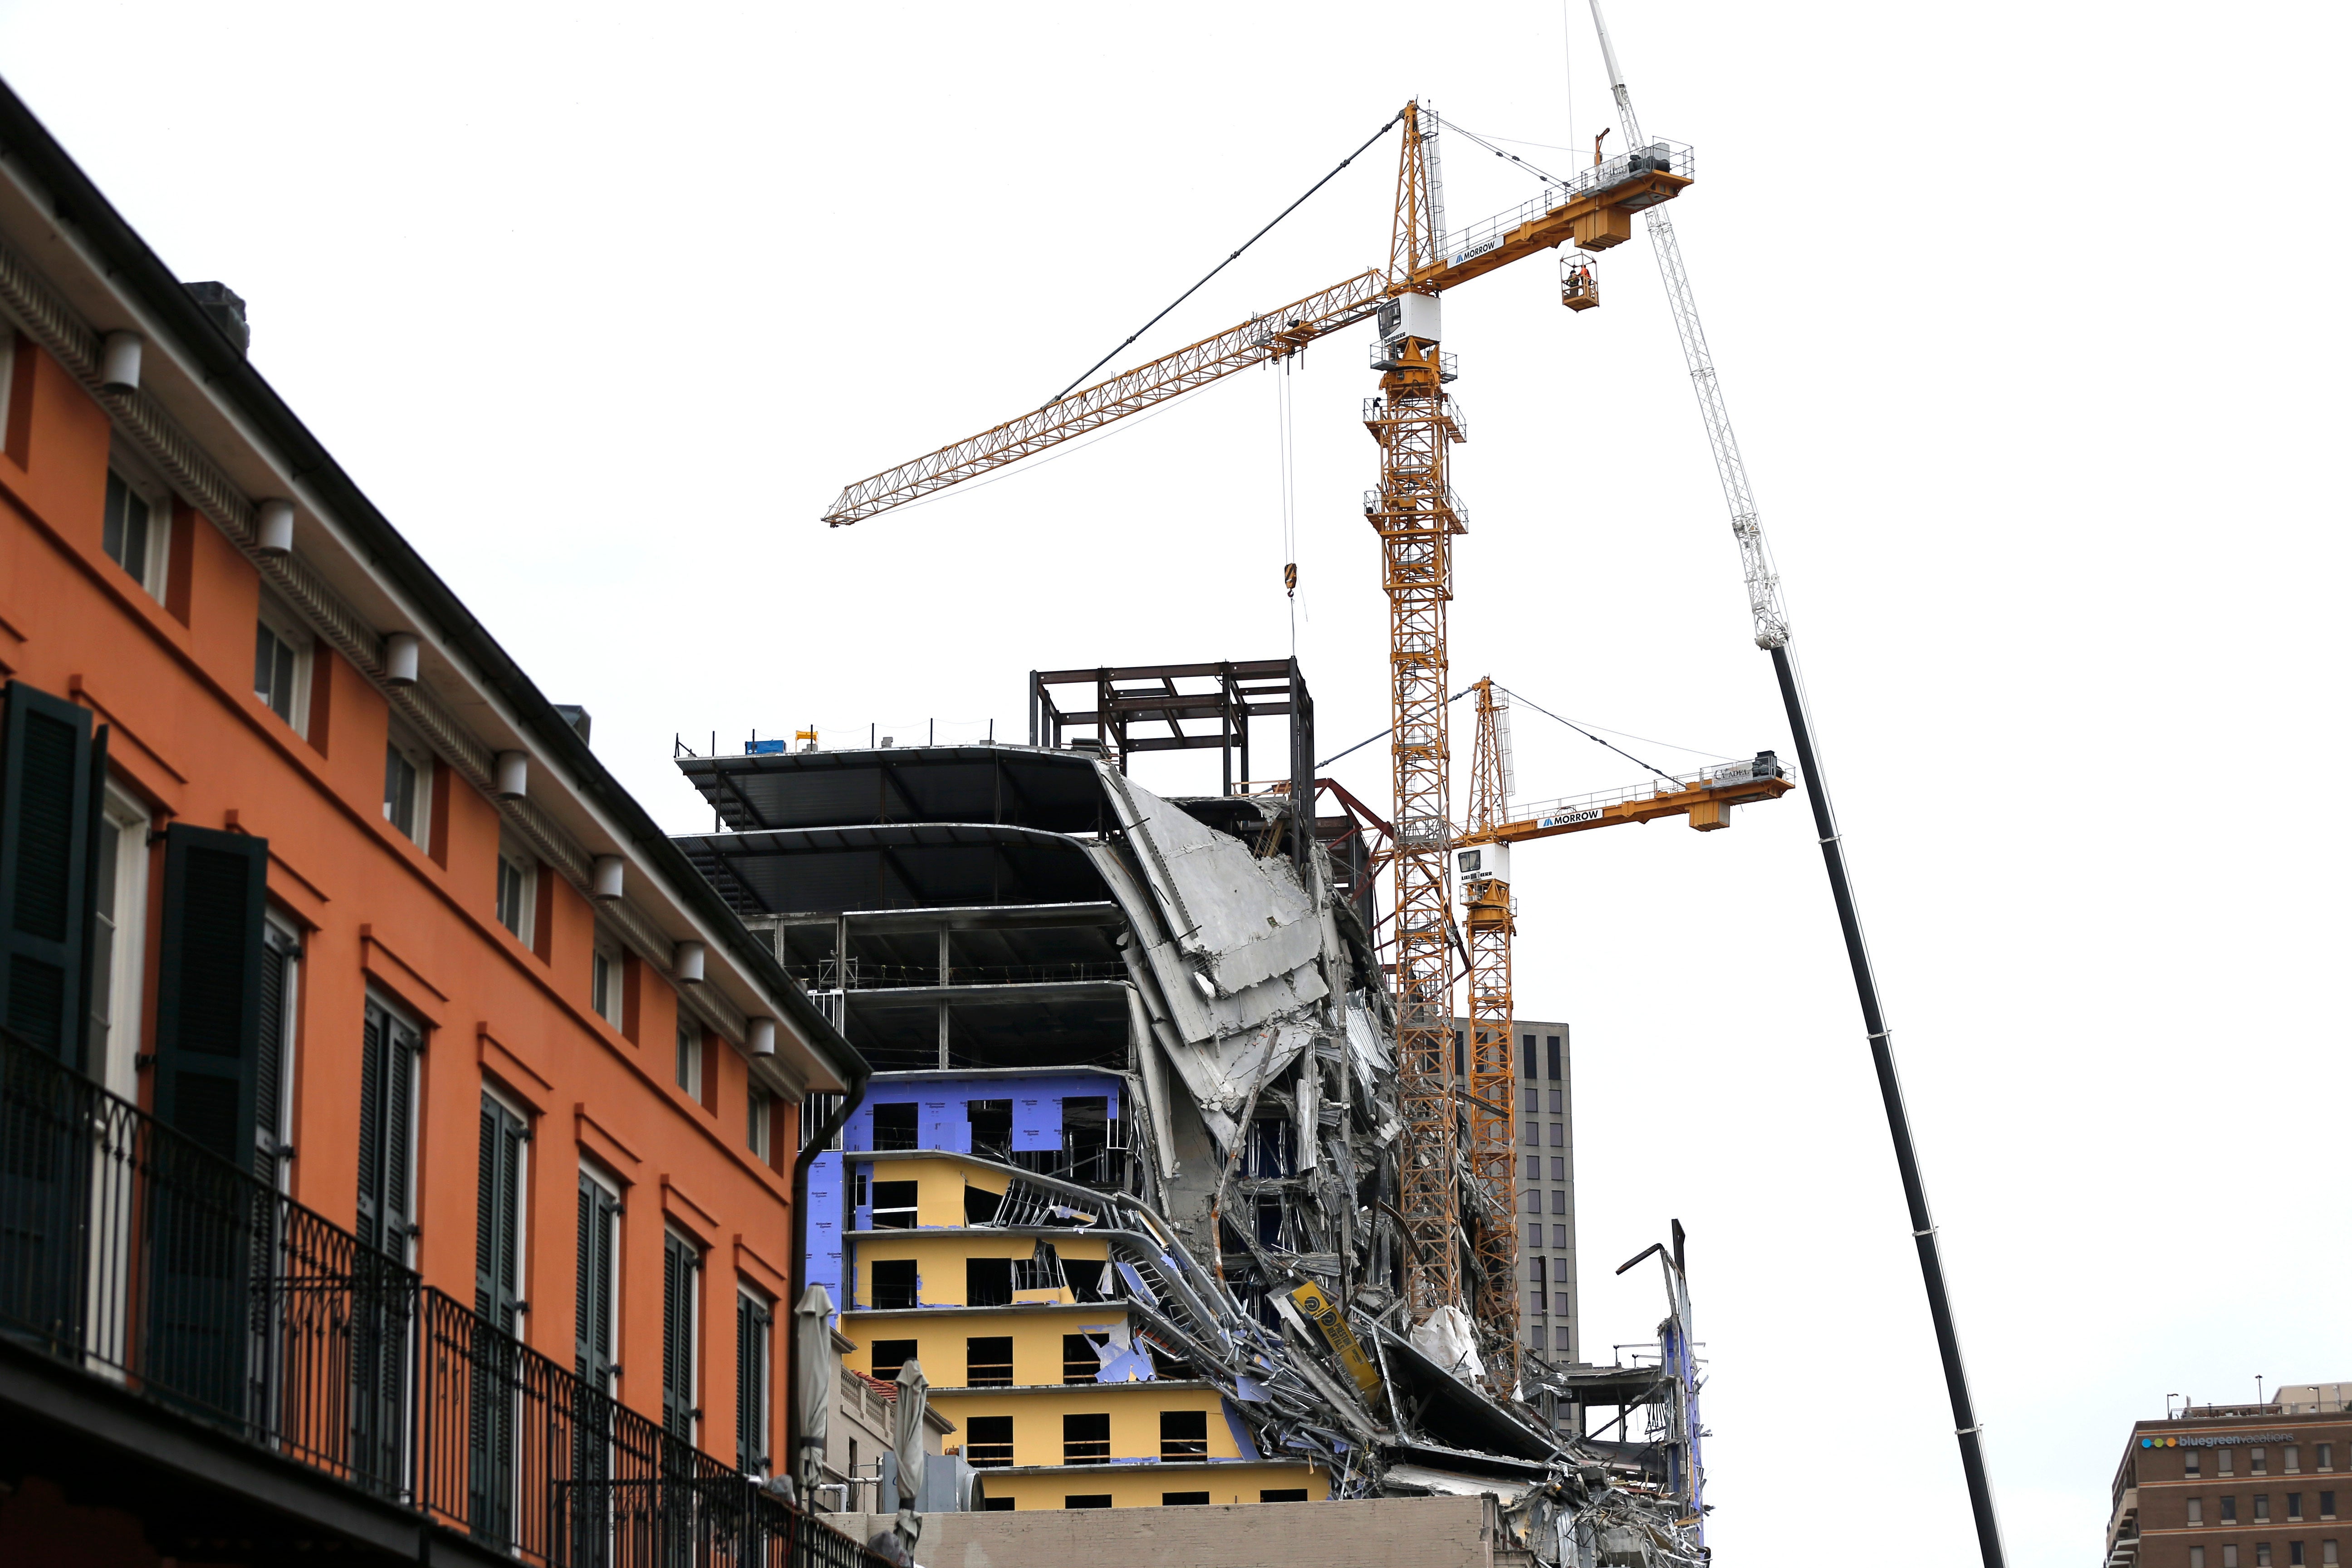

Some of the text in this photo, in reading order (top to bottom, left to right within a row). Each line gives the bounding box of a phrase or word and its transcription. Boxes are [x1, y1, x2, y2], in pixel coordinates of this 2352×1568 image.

[1464, 241, 1495, 260] MORROW
[1385, 332, 1406, 343] LIEBHERR
[1554, 810, 1598, 825] MORROW
[1327, 1326, 1344, 1350] RENTALS
[1334, 1322, 1352, 1346] PRESTON
[1343, 1373, 1354, 1386] DECK
[2179, 1432, 2294, 1447] bluegreenvacations
